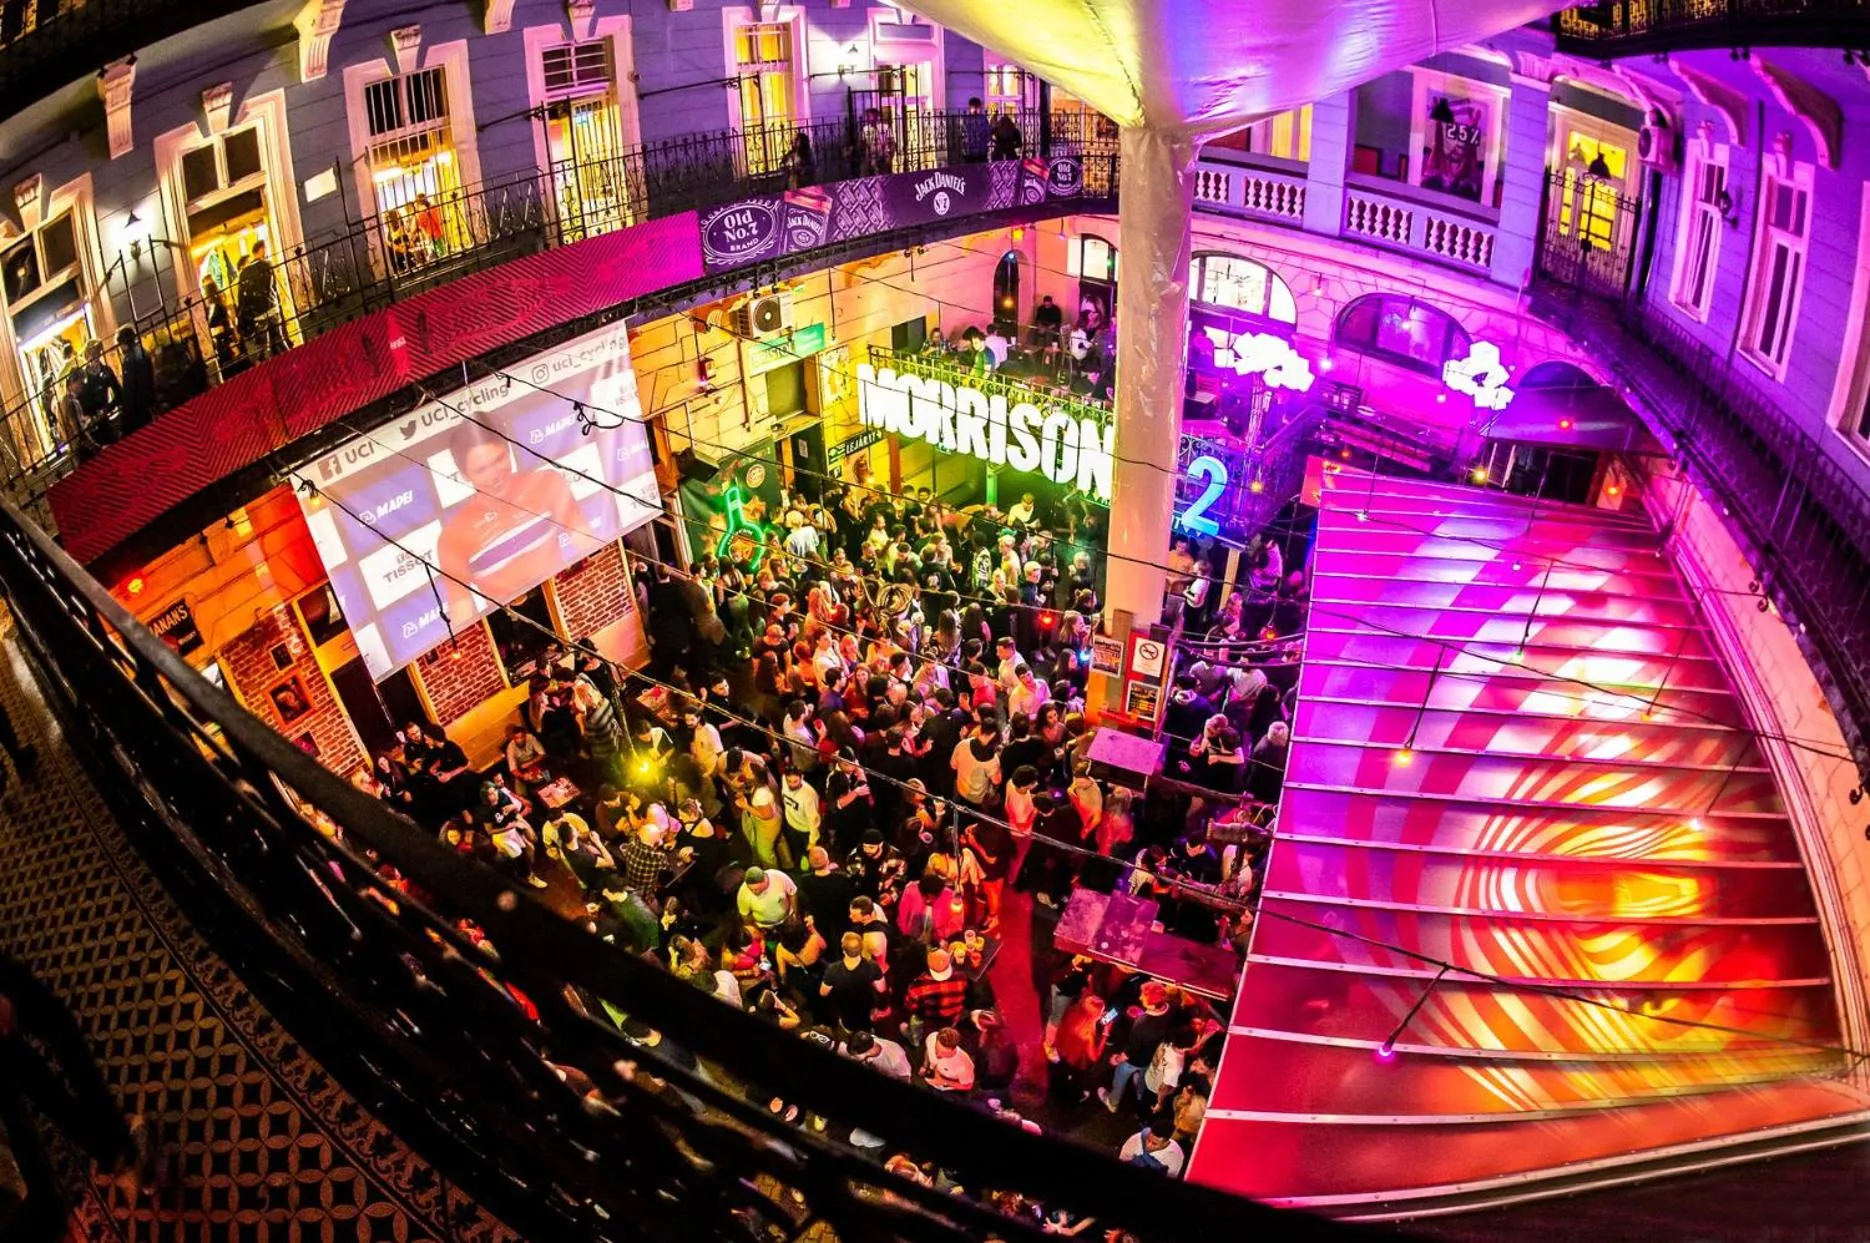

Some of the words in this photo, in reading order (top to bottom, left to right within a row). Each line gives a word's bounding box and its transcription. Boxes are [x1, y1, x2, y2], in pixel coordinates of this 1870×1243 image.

[1447, 123, 1480, 144] 25%
[914, 176, 937, 201] JACK
[934, 171, 966, 196] DANIEL'S
[723, 209, 754, 230] Old
[729, 237, 759, 252] BRAND
[553, 336, 625, 373] uci_cyclng
[421, 383, 509, 427] UCI_cycling
[344, 441, 375, 464] UCI
[1181, 455, 1228, 536] 2
